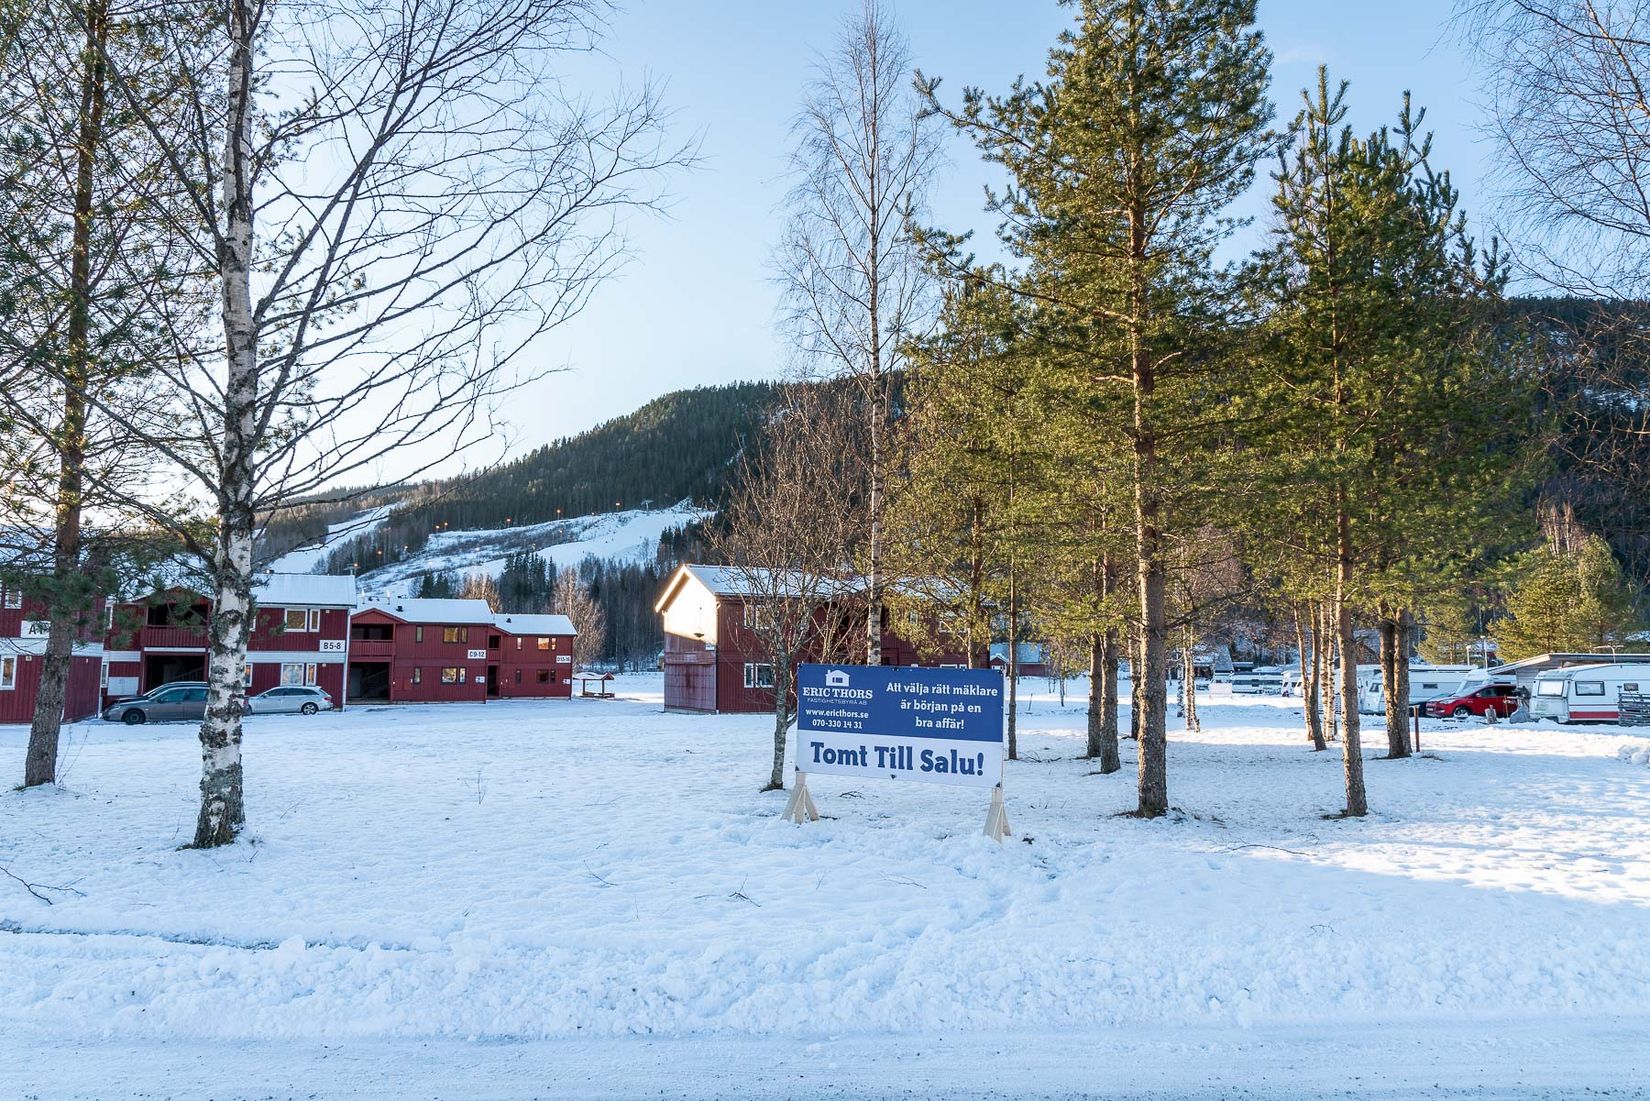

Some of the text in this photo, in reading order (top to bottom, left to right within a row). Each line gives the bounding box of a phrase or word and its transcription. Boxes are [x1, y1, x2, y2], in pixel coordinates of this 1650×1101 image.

[886, 682, 998, 696] Att välja rätt mäklare
[900, 699, 982, 714] är början på en
[805, 709, 869, 718] www.ericthors.se
[812, 719, 841, 728] 070-330
[915, 716, 964, 729] bra affär!
[810, 742, 984, 776] Tomt Till Salu!
